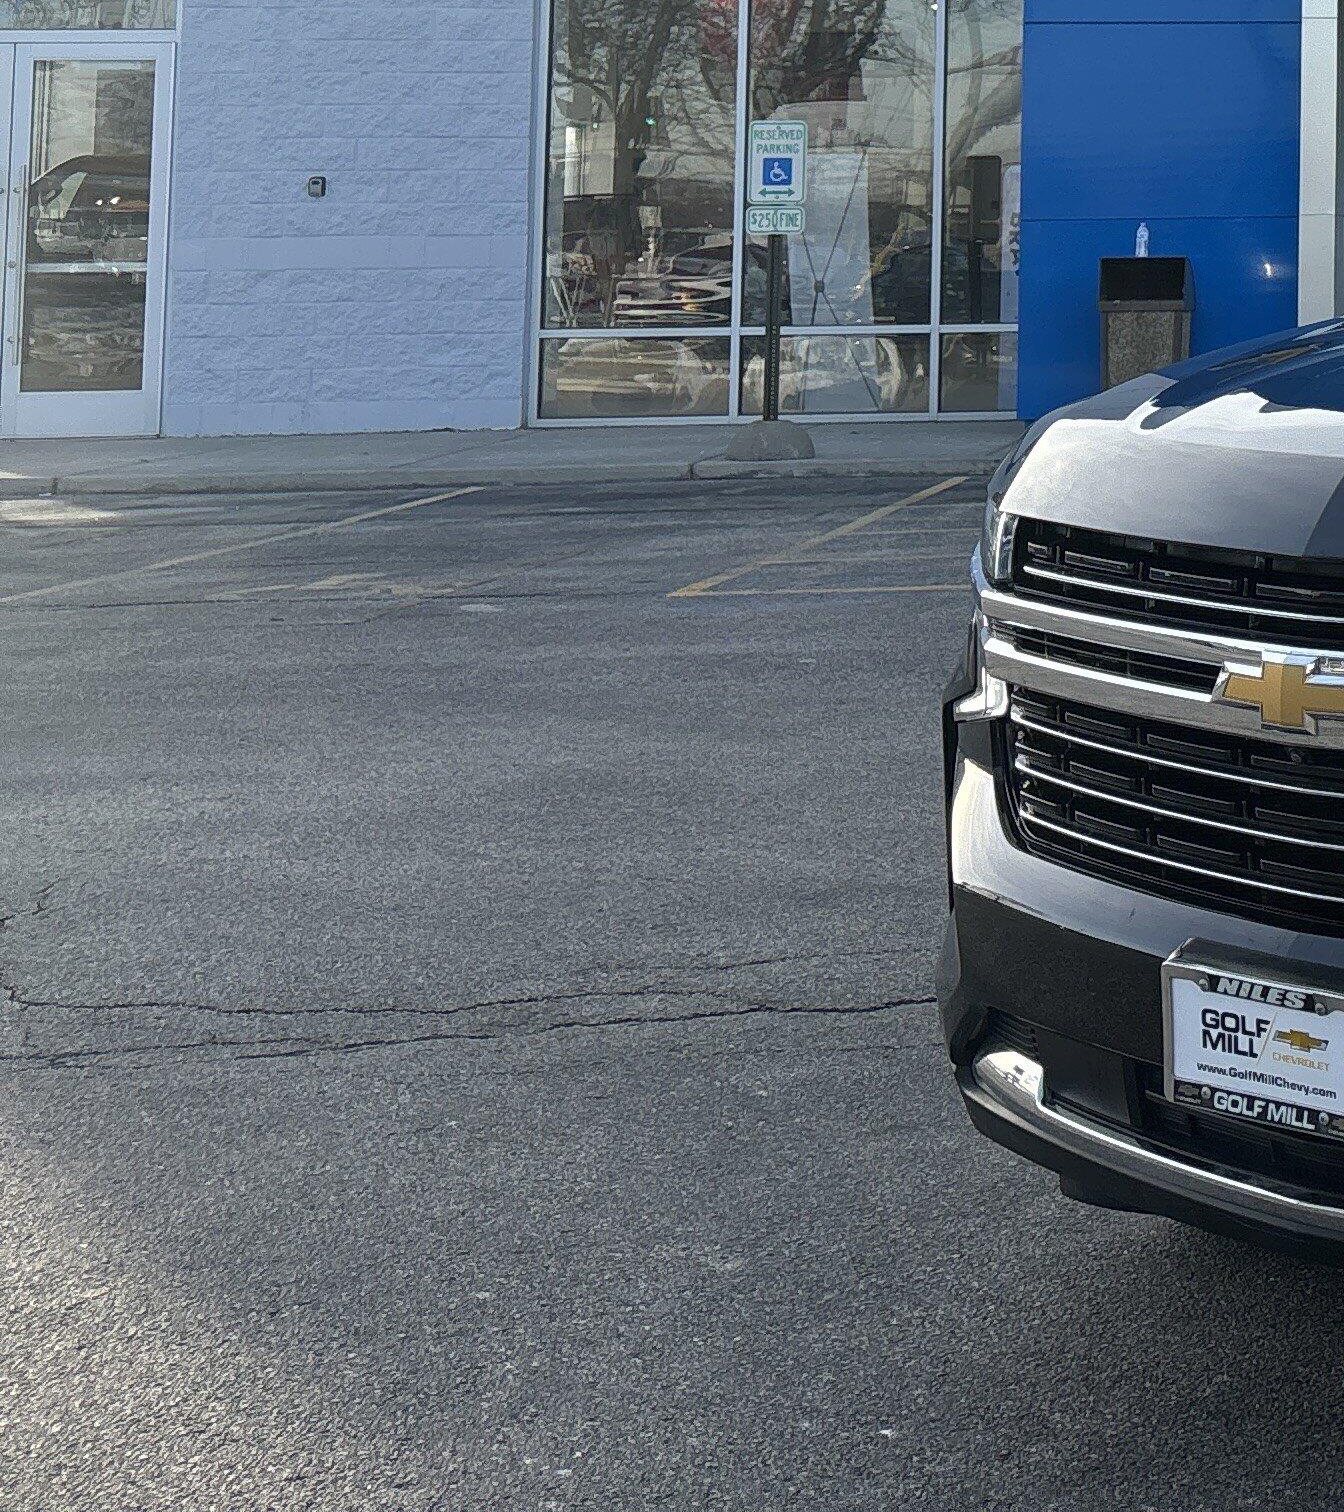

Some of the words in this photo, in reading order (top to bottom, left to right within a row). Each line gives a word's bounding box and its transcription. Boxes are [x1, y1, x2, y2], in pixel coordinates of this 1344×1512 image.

[753, 129, 803, 141] RESERVED
[756, 144, 800, 155] PARKING
[751, 212, 778, 228] $250
[779, 212, 800, 228] FINE
[1216, 977, 1307, 1009] NILES
[1201, 1008, 1271, 1038] GOLF
[1201, 1028, 1260, 1059] MILL
[1272, 1052, 1330, 1072] CHEVROLET
[1196, 1062, 1337, 1100] www.GolfMillChevy.com
[1213, 1091, 1266, 1118] GOLF
[1267, 1105, 1316, 1130] MILL
